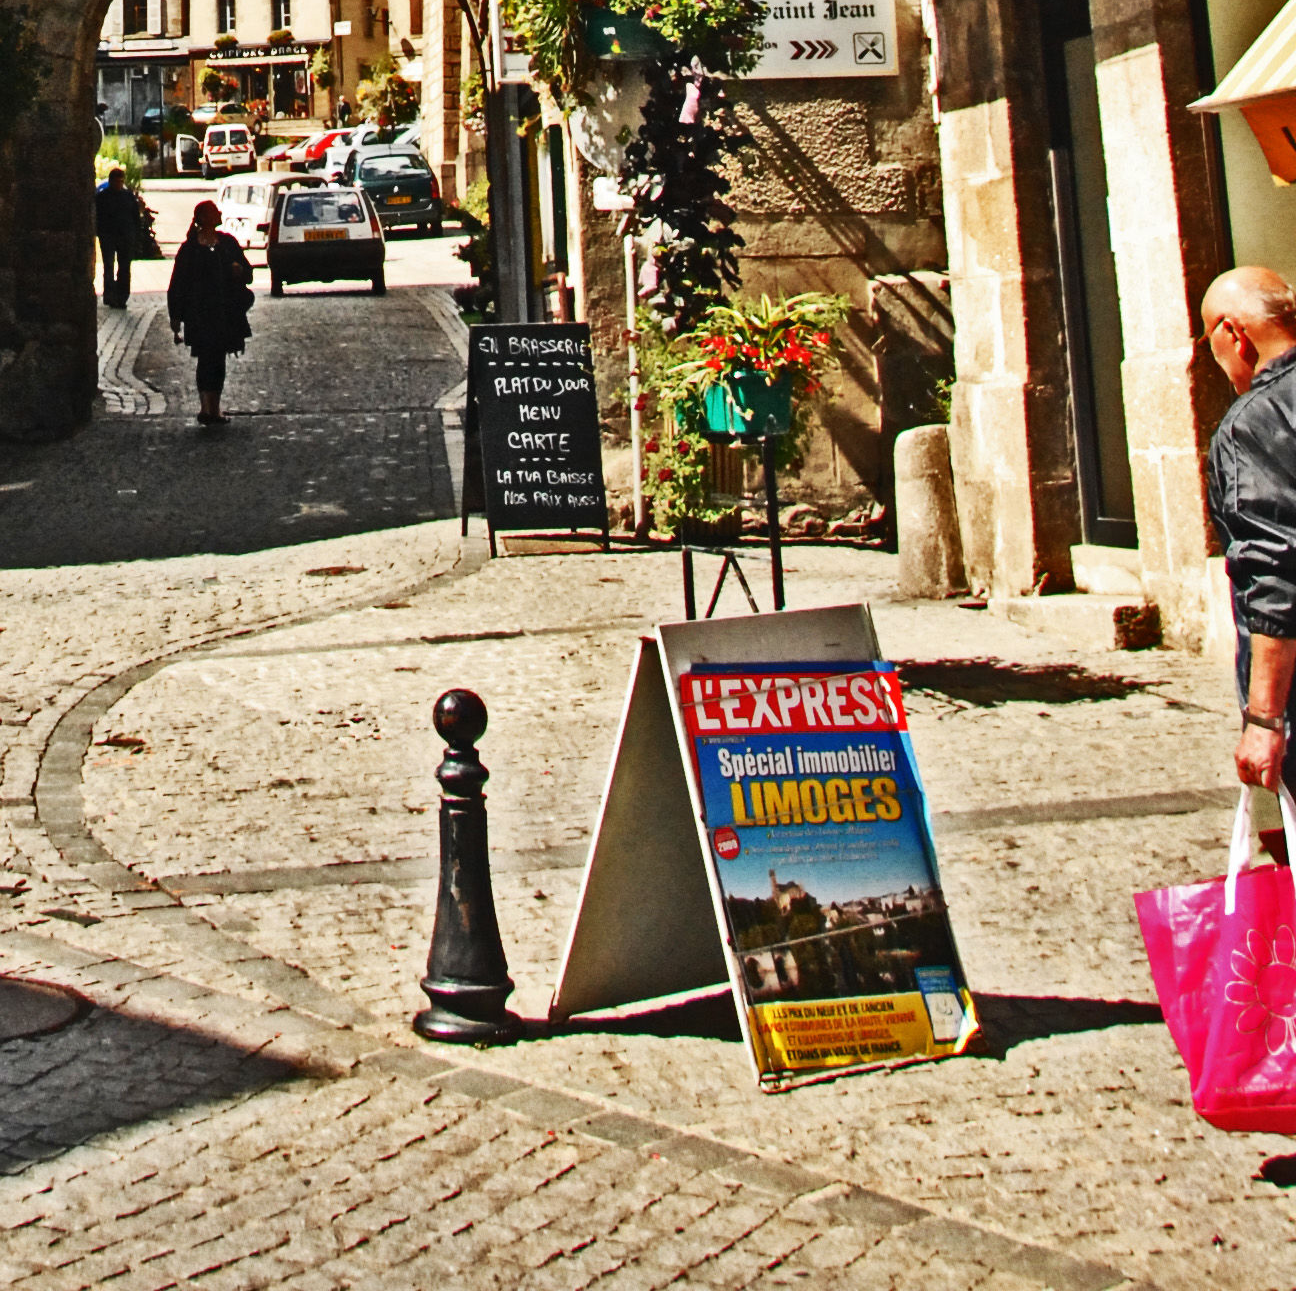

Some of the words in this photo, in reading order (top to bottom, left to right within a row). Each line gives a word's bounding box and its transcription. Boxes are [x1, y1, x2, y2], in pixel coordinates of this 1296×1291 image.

[823, 0, 875, 20] Jean
[478, 336, 499, 354] EN
[508, 336, 587, 358] BRASSERIE
[494, 376, 530, 397] PLAT
[533, 376, 552, 393] DU
[553, 378, 591, 397] JOUR
[519, 404, 561, 423] MENU
[507, 431, 571, 453] CARTE
[496, 469, 512, 484] LA
[517, 470, 542, 484] TVA
[504, 490, 528, 506] NOS
[691, 674, 899, 731] L'EXPRESS
[717, 745, 794, 782] Spécial
[797, 744, 896, 775] immobilier
[730, 776, 903, 827] LIMOGES
